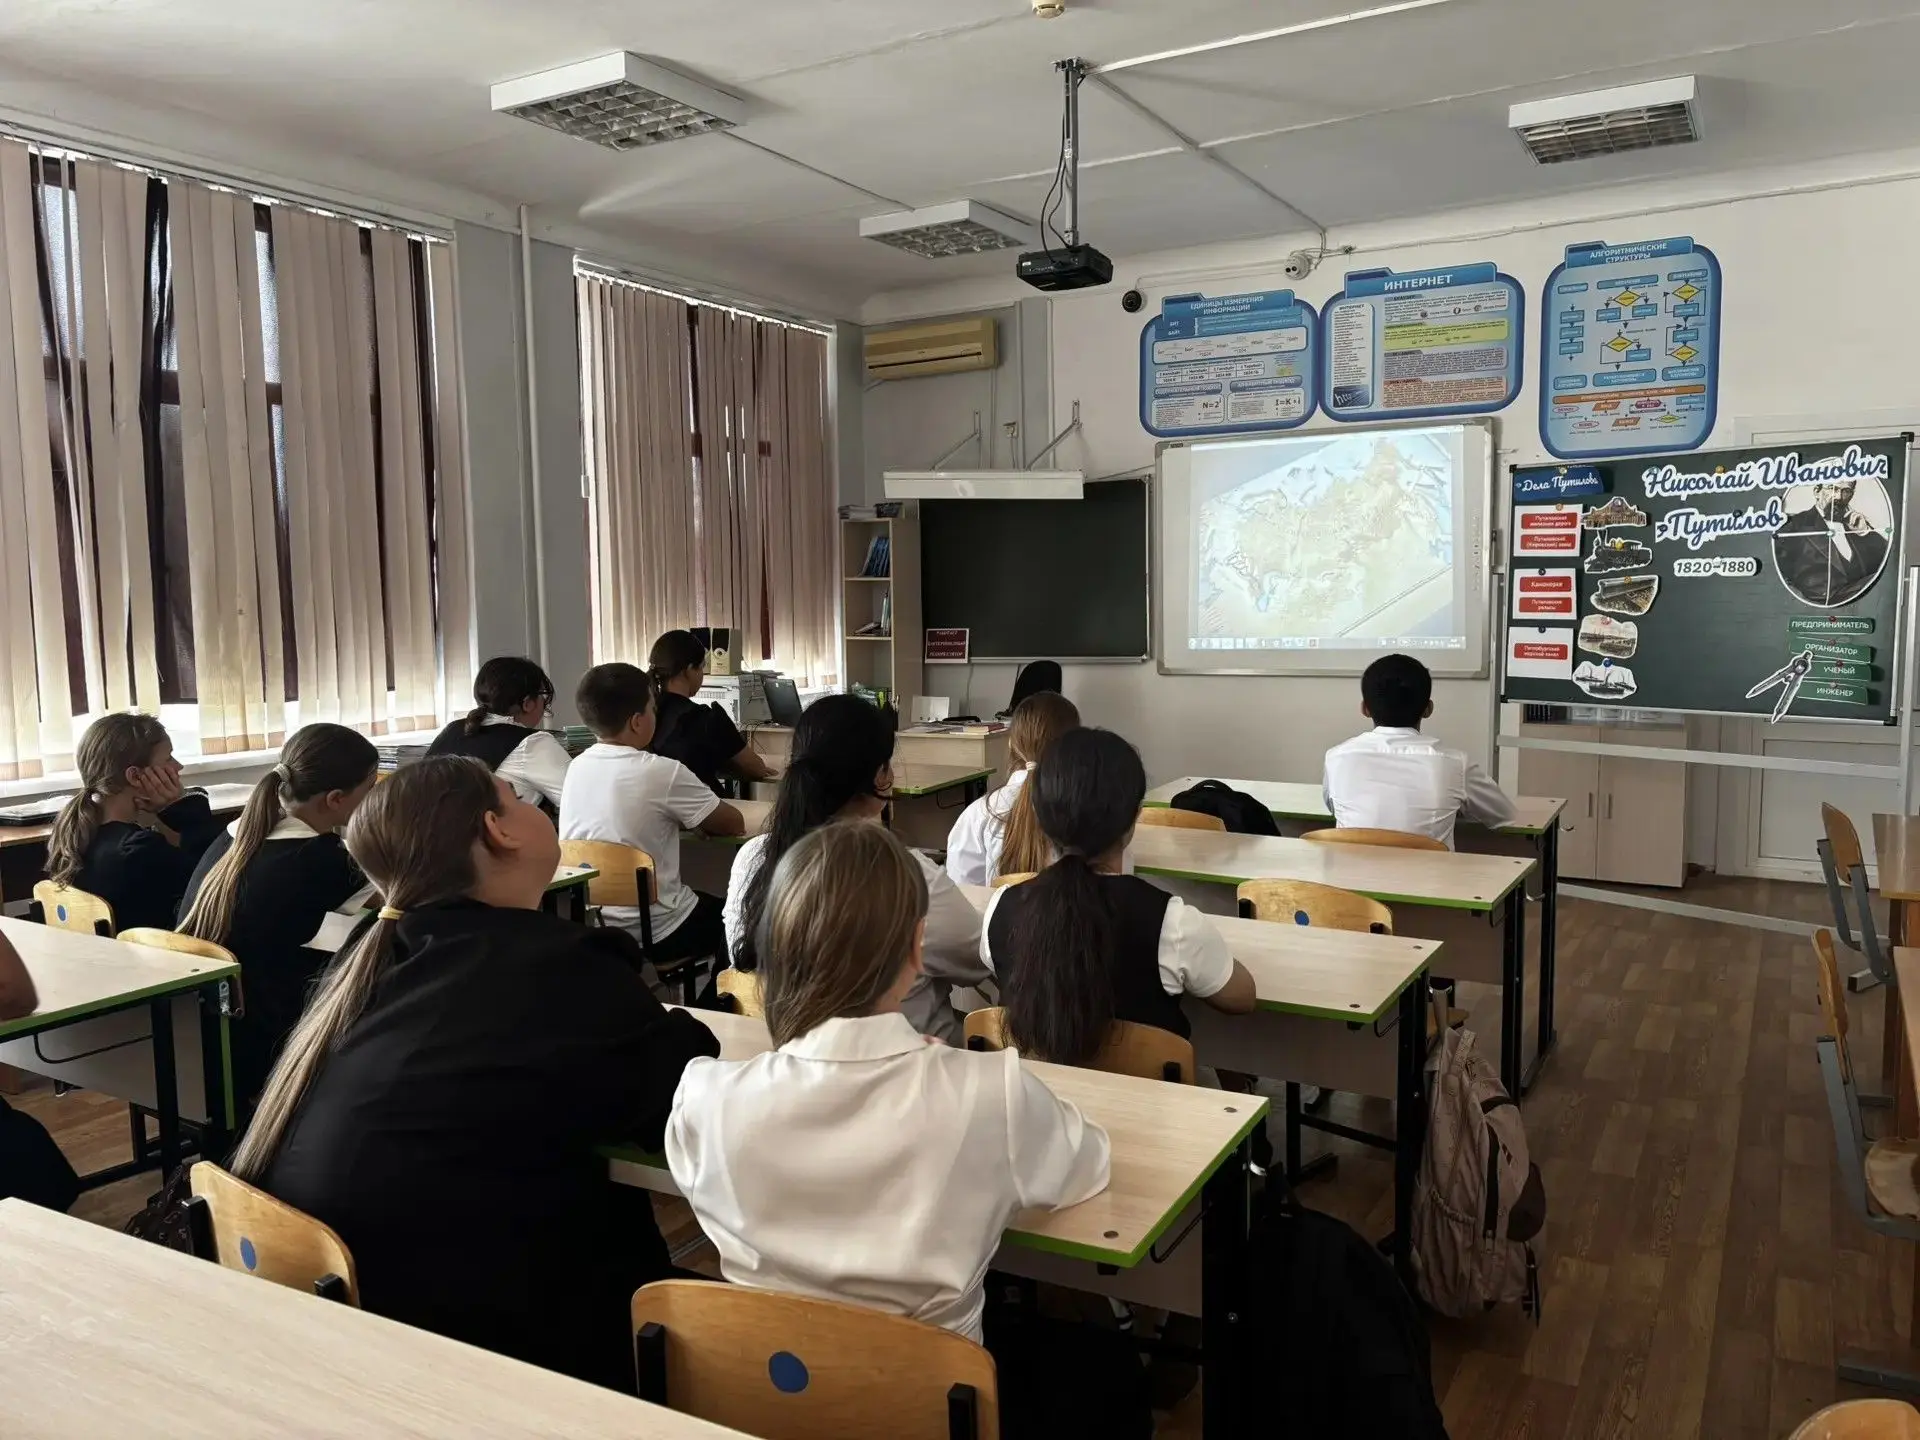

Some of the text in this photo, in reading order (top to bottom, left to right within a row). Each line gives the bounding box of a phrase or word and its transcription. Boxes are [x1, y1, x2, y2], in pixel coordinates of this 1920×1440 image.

[1590, 243, 1668, 258] АЛГОРИТМИЧЕСКИЕ
[1605, 253, 1651, 264] СТРУКТУРЫ
[1384, 274, 1453, 291] ИНТЕРНЕТ
[1191, 296, 1264, 310] ЕДИНИЦЫ ИЗМЕРЕНИЯ
[1203, 305, 1251, 315] ИНФОРМАЦИИ
[1648, 449, 1887, 493] Николай Иванович
[1518, 472, 1599, 493] Дела Путилова
[1657, 499, 1783, 547] Путилов
[1791, 620, 1869, 629] ПРЕДПРИНИМАТЕЛЬ
[1804, 643, 1858, 655] ОРГАНИЗАТОР
[1816, 687, 1854, 697] ИНЖЕНЕР
